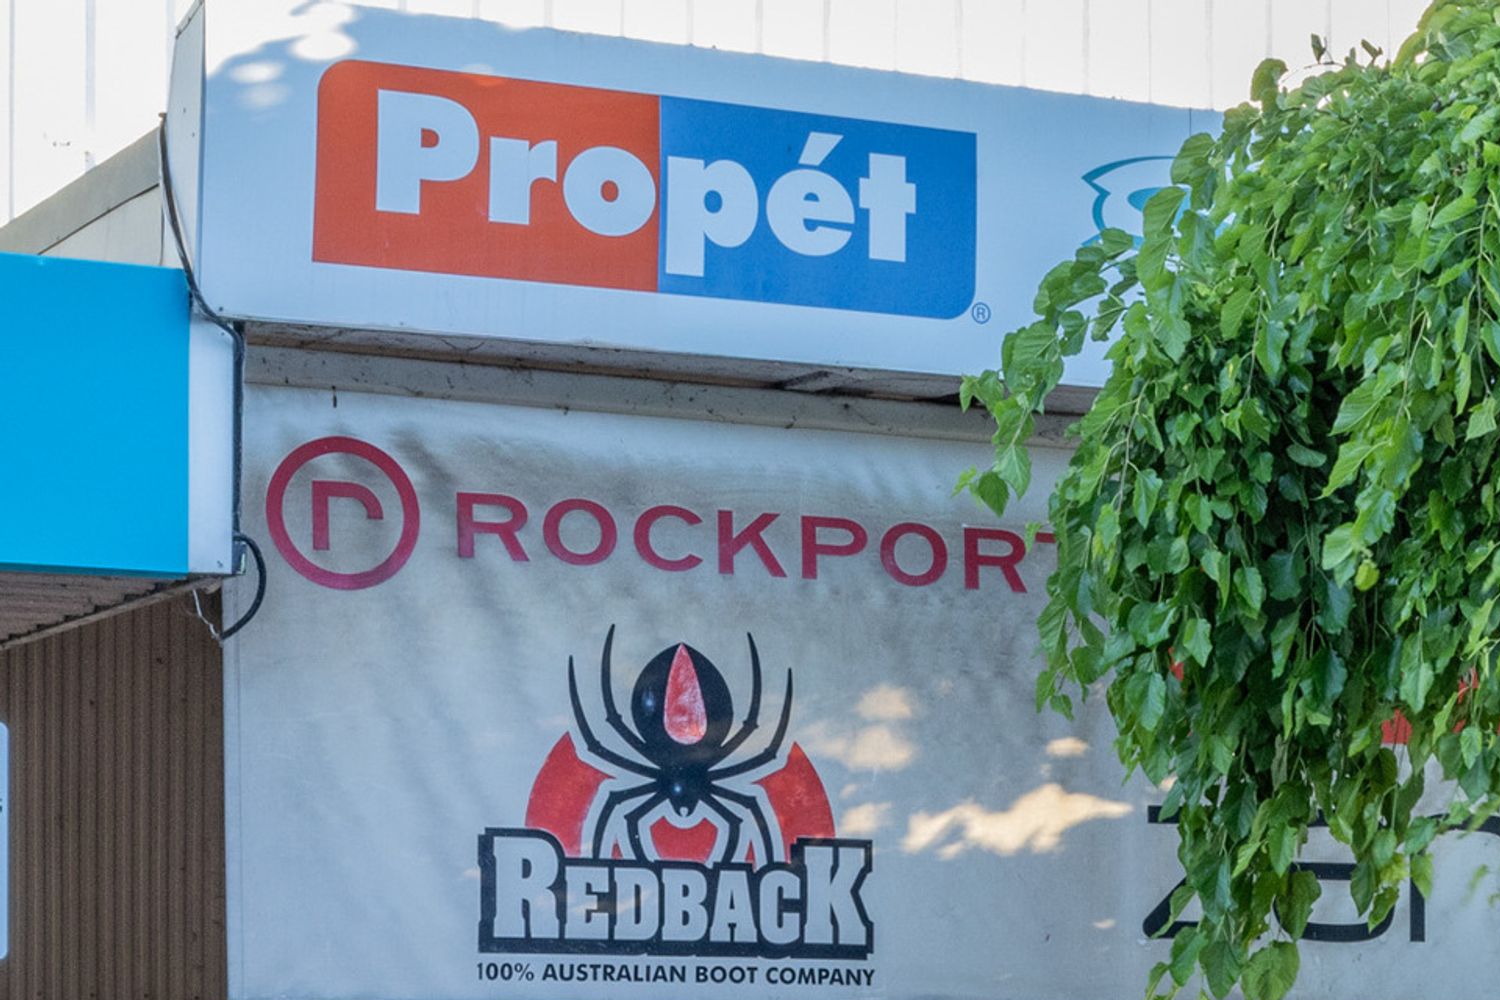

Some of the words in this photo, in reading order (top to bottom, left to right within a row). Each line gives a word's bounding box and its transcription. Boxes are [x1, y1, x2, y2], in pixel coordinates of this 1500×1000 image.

[375, 88, 916, 277] Propét
[456, 491, 1056, 593] ROCKPOR
[477, 962, 535, 982] 100%
[541, 963, 686, 983] AUSTRALIAN
[695, 965, 757, 984] BOOT
[765, 967, 875, 986] COMPANY
